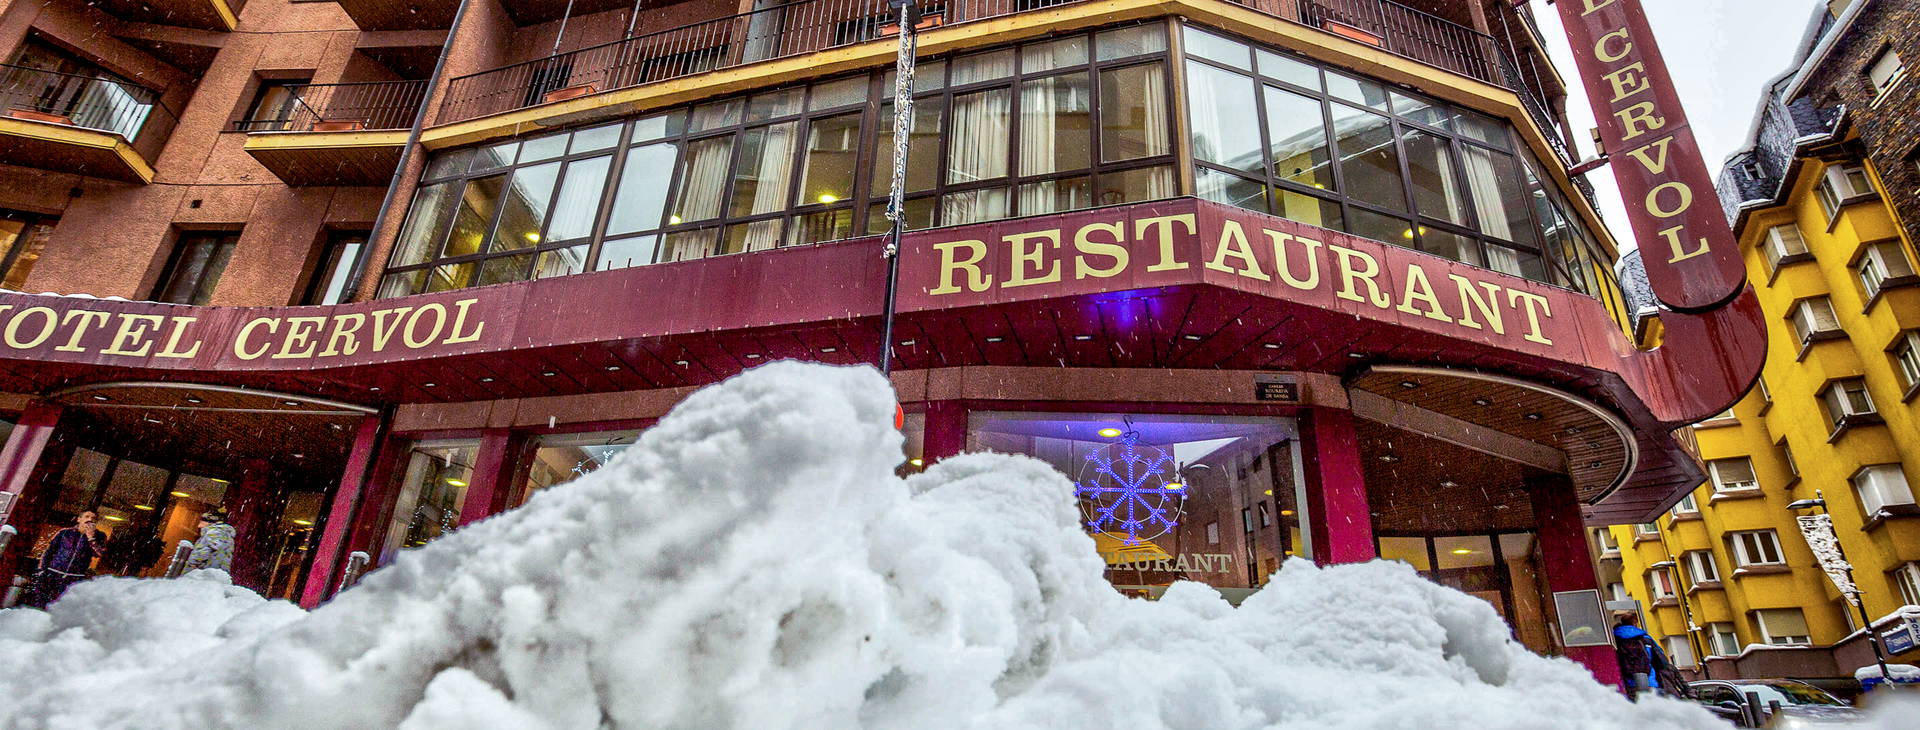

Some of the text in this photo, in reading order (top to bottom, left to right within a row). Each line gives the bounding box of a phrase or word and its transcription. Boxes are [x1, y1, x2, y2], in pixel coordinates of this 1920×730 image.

[1594, 27, 1710, 264] CERVOL
[929, 213, 1553, 346] RESTAURANT
[0, 298, 485, 360] OTEL CERVOL
[1100, 552, 1232, 573] TAURANT
